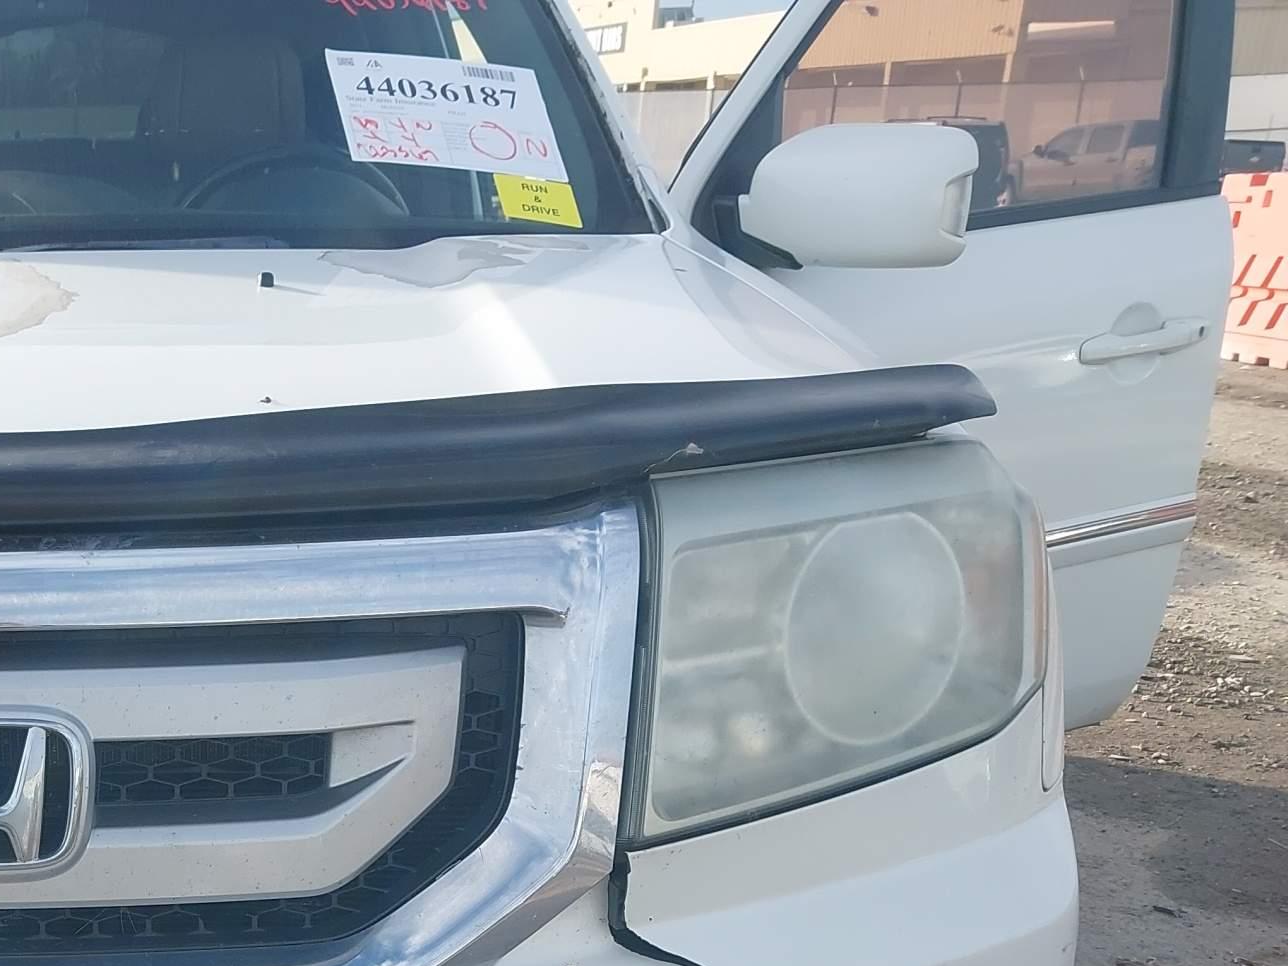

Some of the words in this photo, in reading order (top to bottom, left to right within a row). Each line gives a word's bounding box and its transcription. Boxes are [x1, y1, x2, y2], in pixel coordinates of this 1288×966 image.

[356, 75, 517, 109] 44036187
[521, 182, 549, 194] RUN
[534, 195, 542, 203] &
[521, 203, 561, 217] DRIVE
